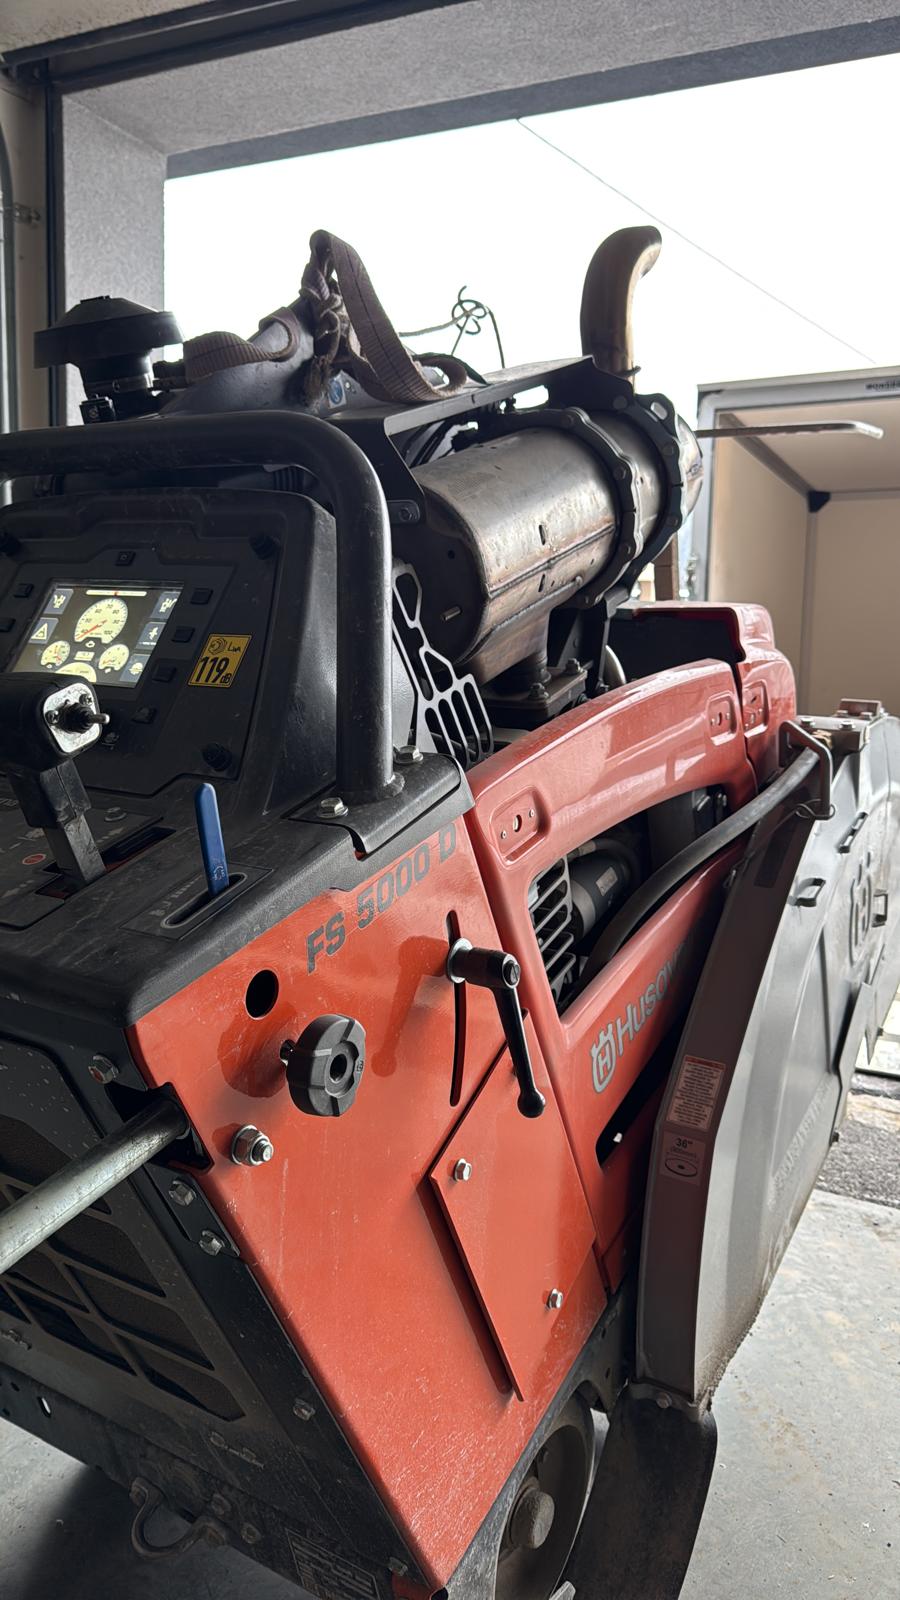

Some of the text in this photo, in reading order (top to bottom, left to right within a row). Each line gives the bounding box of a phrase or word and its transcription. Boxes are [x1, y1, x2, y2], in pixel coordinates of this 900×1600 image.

[195, 656, 230, 683] 119
[306, 822, 457, 974] FS 5000 D
